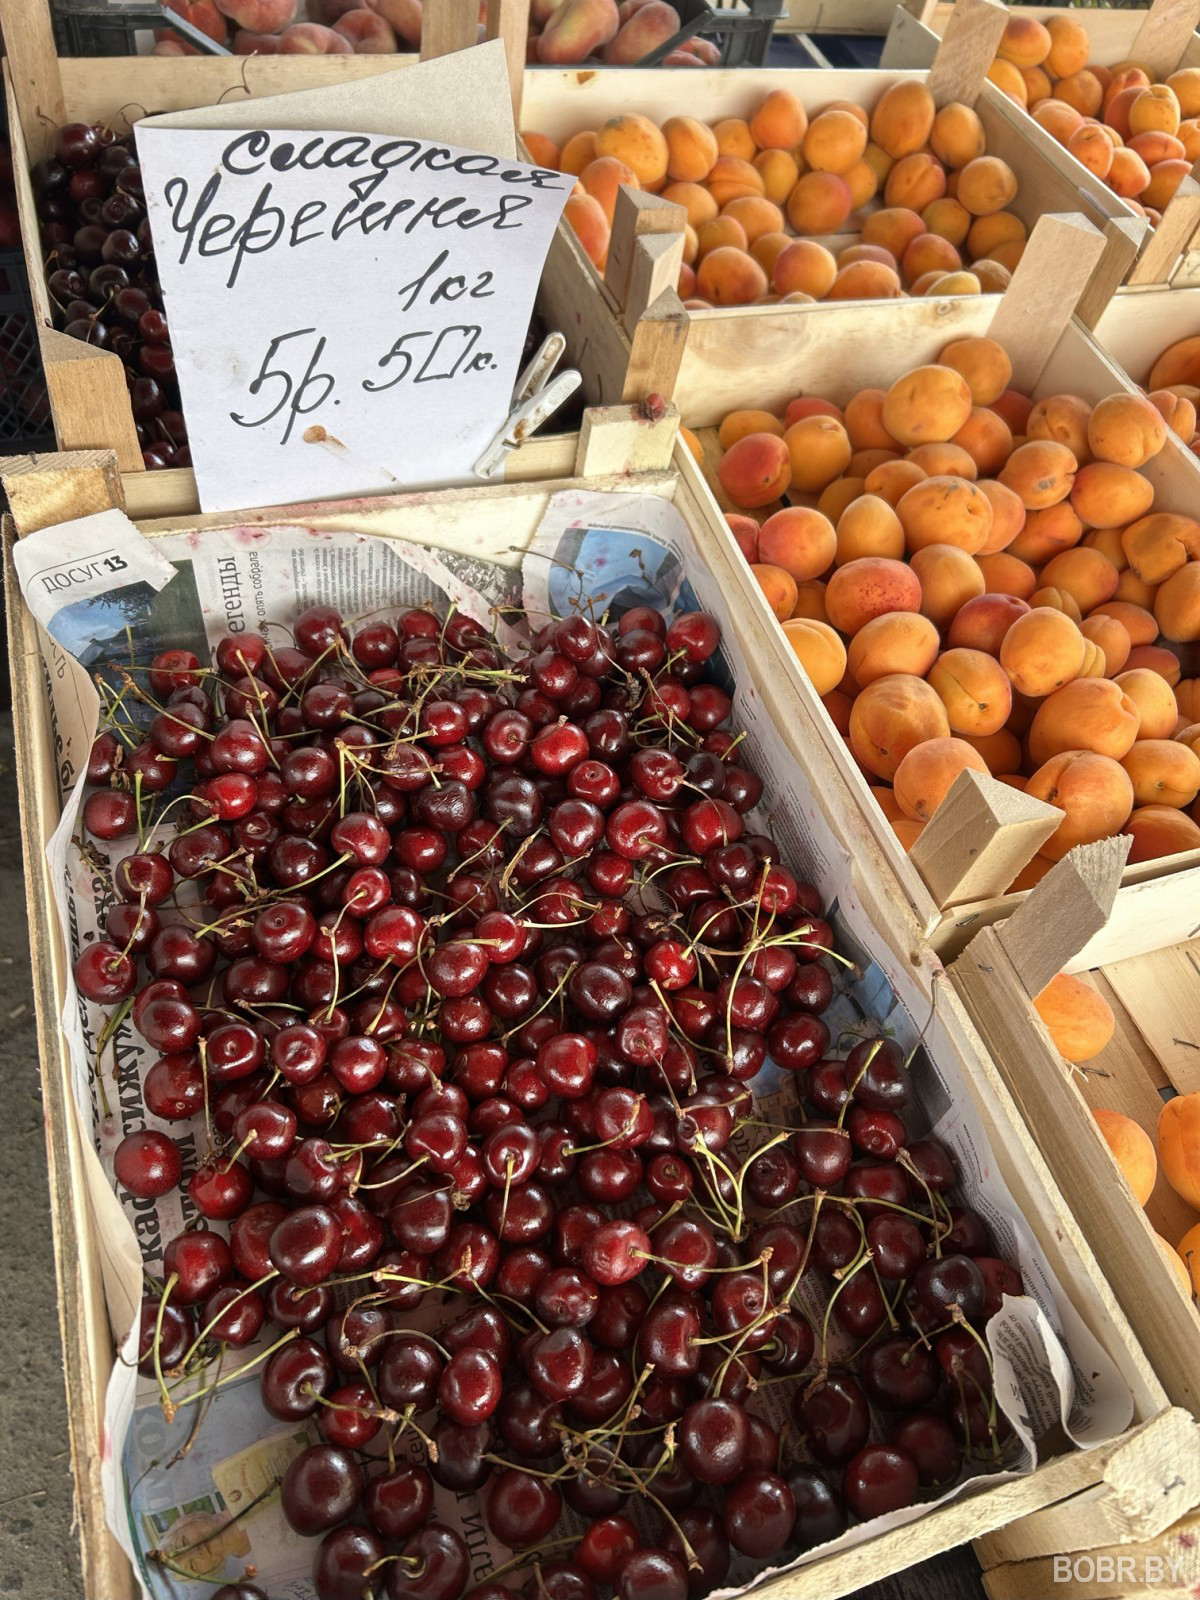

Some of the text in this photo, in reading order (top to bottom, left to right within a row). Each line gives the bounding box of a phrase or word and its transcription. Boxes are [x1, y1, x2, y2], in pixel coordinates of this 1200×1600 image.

[40, 555, 129, 594] ДОСУГ 13
[249, 552, 263, 589] собрала
[218, 556, 245, 633] егенды
[255, 591, 265, 616] опять
